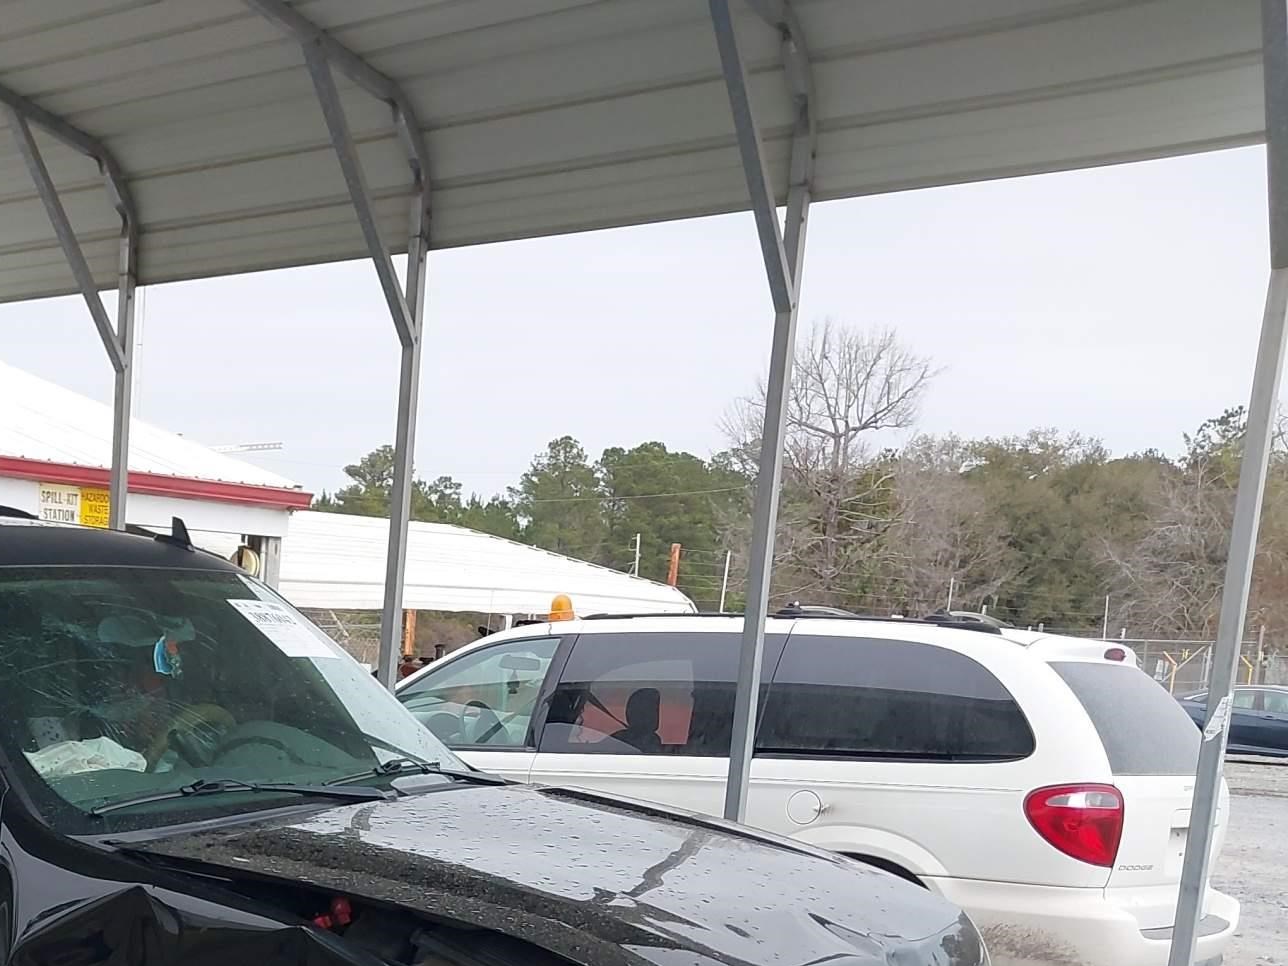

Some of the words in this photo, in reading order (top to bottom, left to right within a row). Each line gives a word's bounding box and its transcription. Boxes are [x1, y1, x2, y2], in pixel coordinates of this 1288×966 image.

[41, 490, 62, 504] SPILL
[81, 492, 109, 503] HAZARDO
[43, 508, 75, 521] STATION
